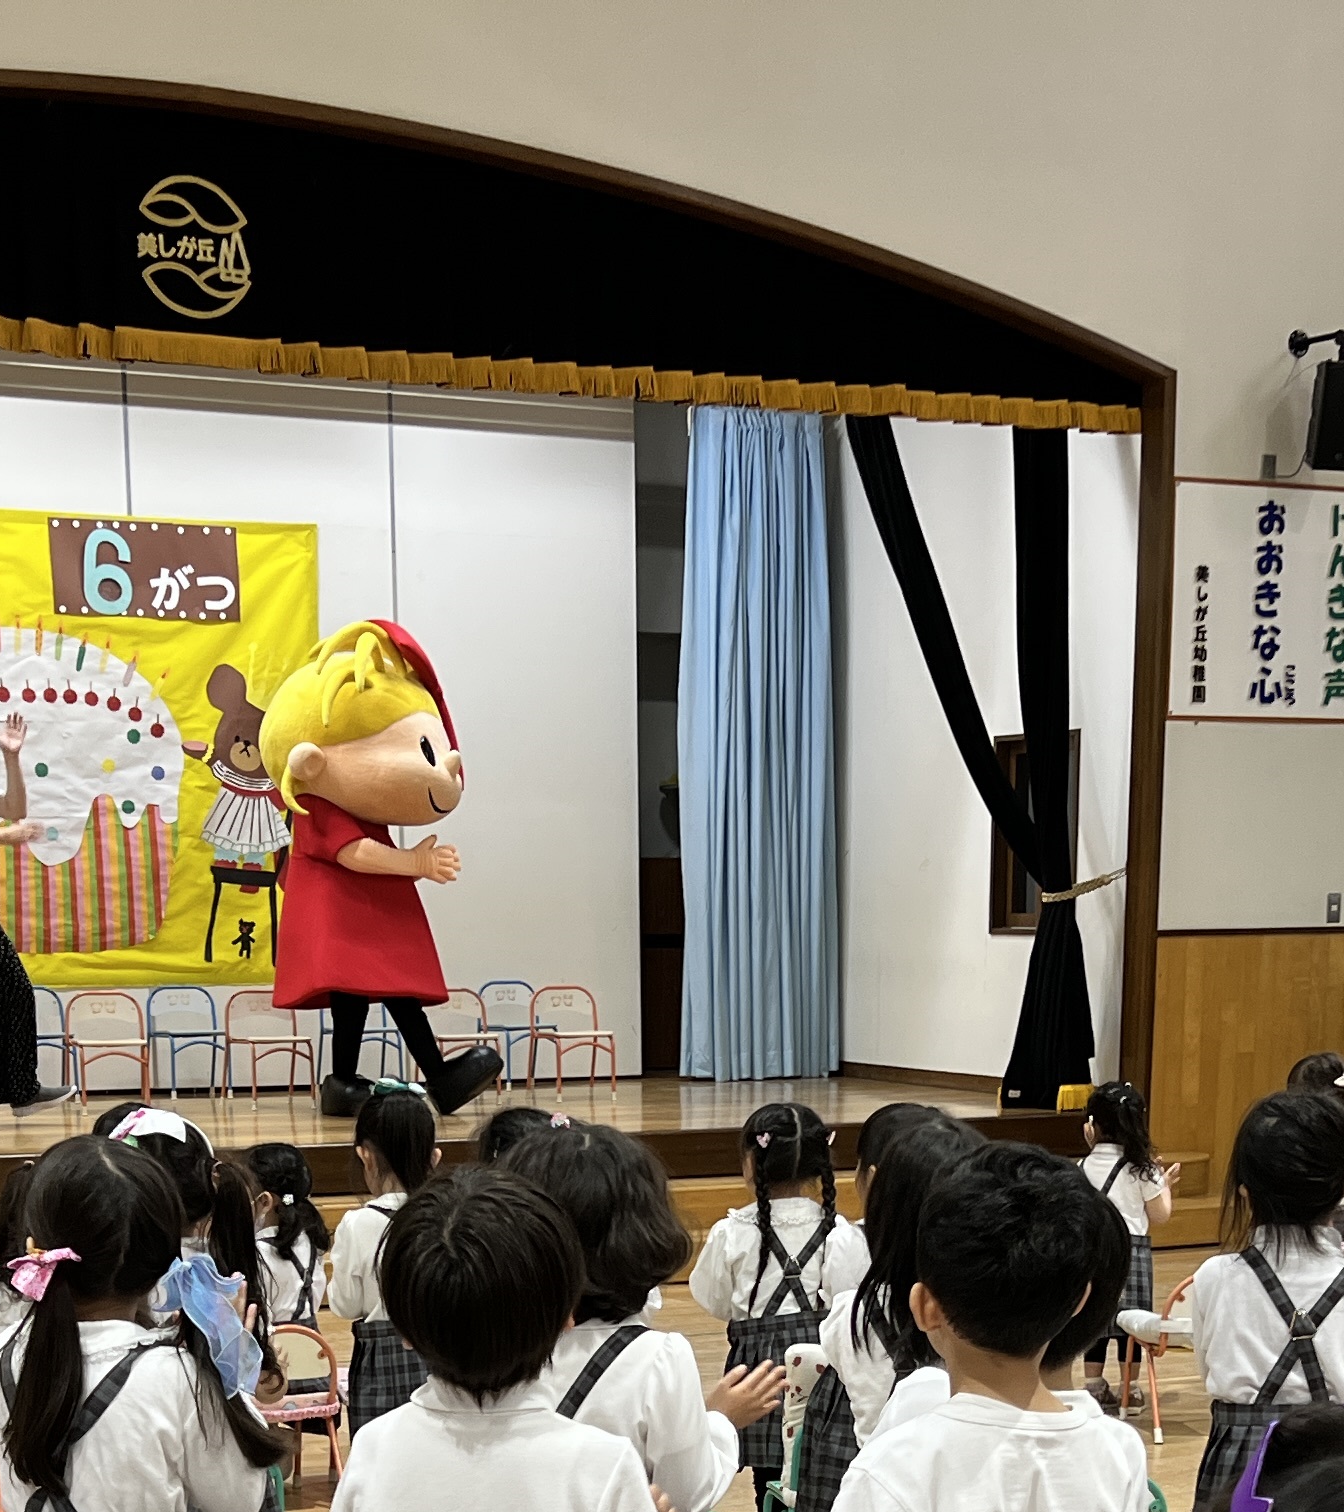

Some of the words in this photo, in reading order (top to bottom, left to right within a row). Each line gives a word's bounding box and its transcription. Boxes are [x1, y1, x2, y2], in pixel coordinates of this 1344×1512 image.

[137, 232, 216, 262] 美しが丘
[1249, 500, 1286, 704] おおきな心
